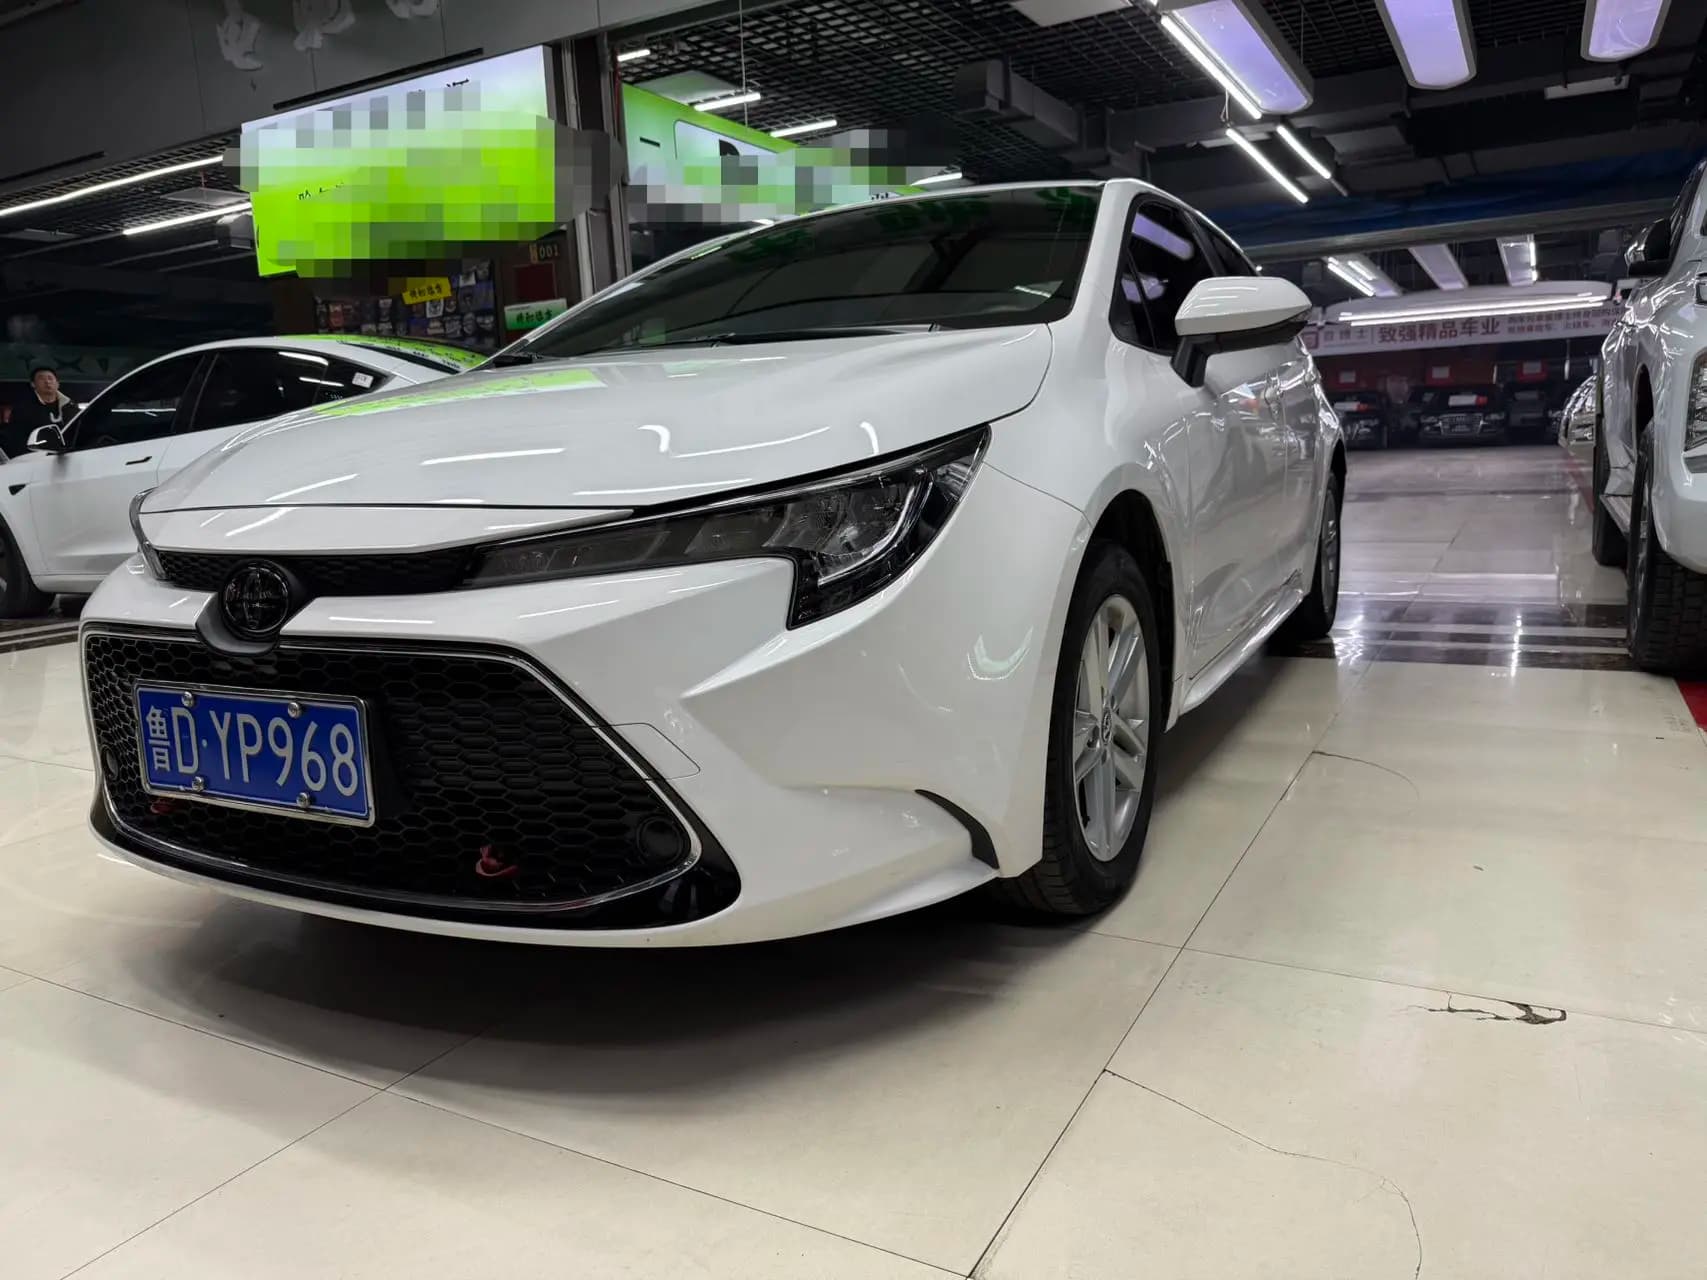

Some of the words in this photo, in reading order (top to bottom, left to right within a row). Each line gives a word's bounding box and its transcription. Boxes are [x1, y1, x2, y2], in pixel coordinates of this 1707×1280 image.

[1378, 317, 1501, 344] 致强精品车业
[146, 705, 359, 797] 鲁D·YP968
